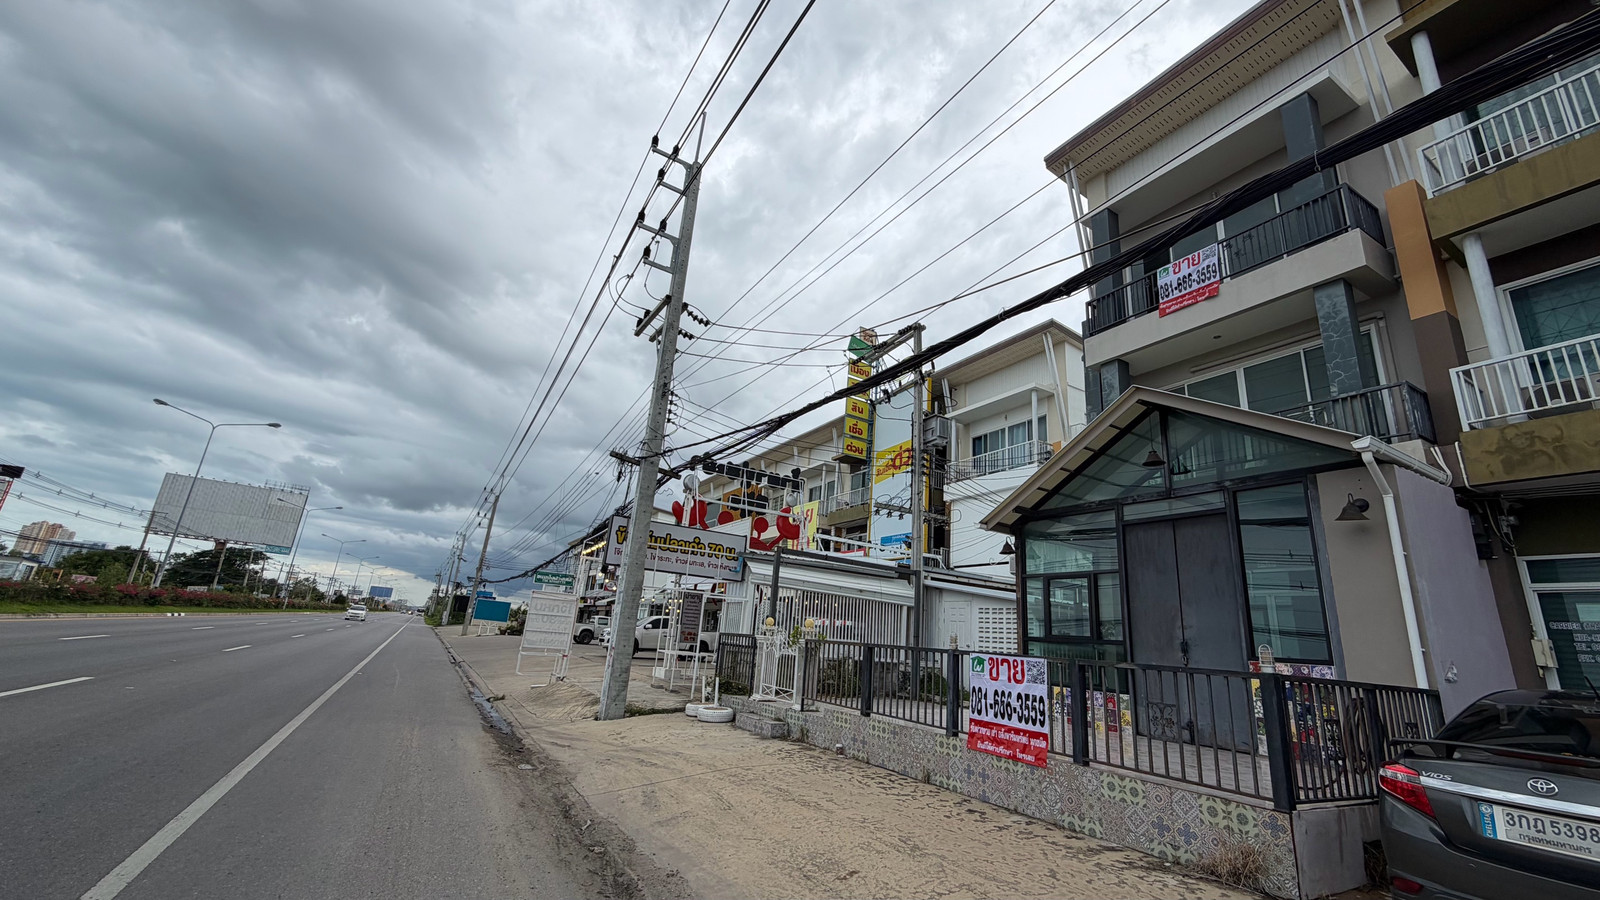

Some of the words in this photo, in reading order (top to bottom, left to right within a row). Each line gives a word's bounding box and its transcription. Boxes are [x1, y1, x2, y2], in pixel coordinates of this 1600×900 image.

[1171, 252, 1201, 275] ขาย
[1160, 262, 1217, 300] 081-666-3559
[846, 442, 864, 456] ด่วน
[707, 542, 724, 559] 70
[988, 656, 1026, 685] ขาย
[971, 685, 1046, 728] 081-666-3559
[1421, 770, 1453, 781] VIOS
[1518, 833, 1592, 854] กรุงเทพมหานคร
[1549, 820, 1600, 844] 5398
